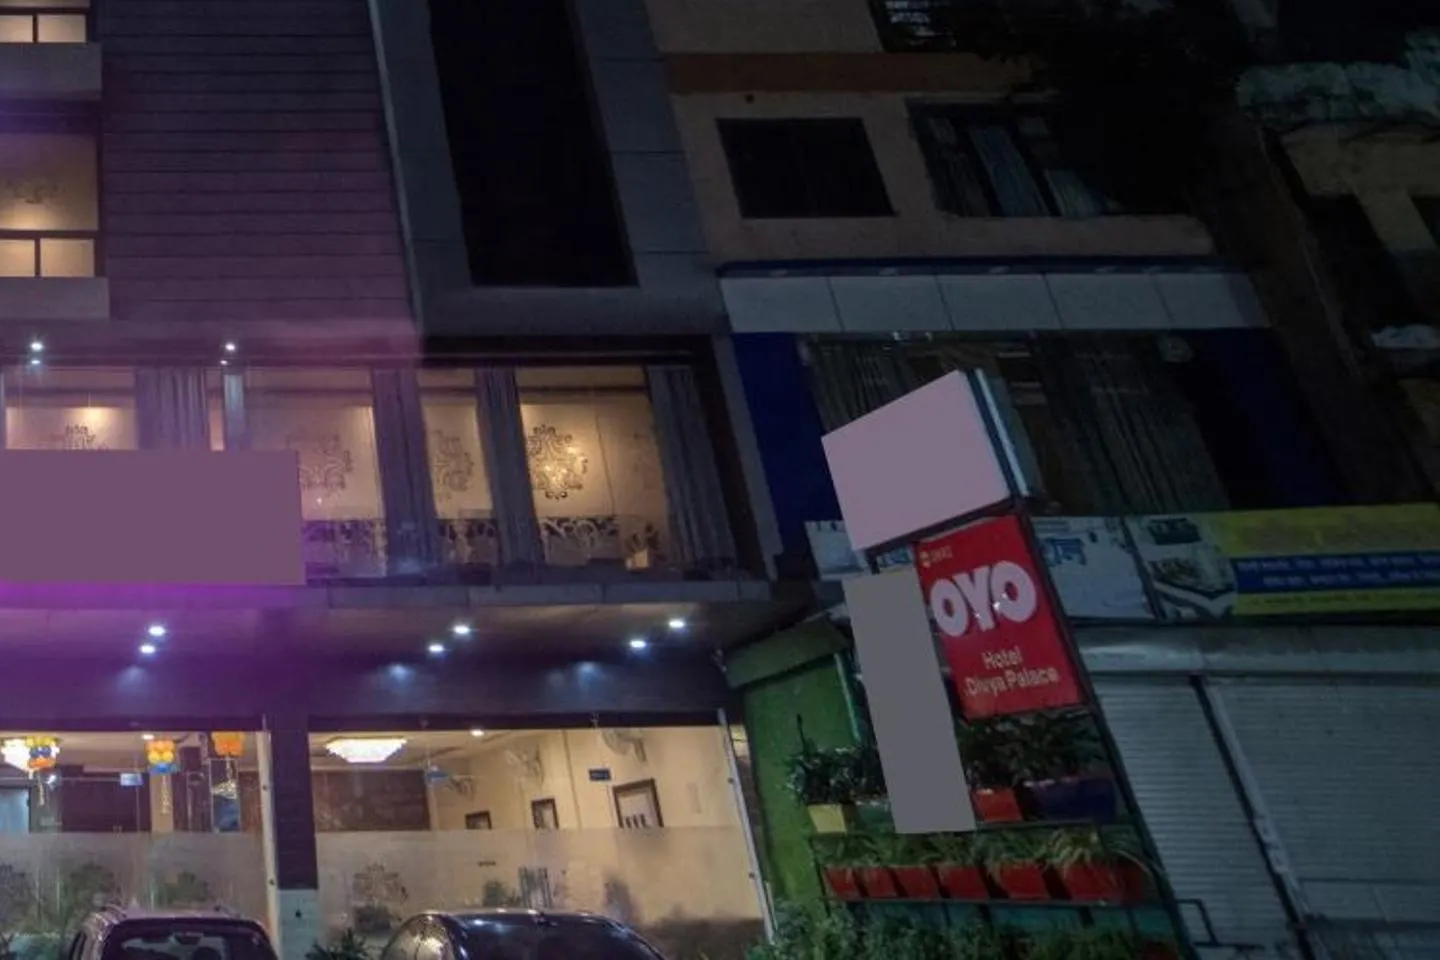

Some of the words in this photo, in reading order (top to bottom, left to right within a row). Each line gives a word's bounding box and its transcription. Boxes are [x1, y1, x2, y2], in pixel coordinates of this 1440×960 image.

[929, 560, 1038, 637] OYO
[981, 645, 1024, 669] Hotel
[1003, 666, 1059, 688] Palace
